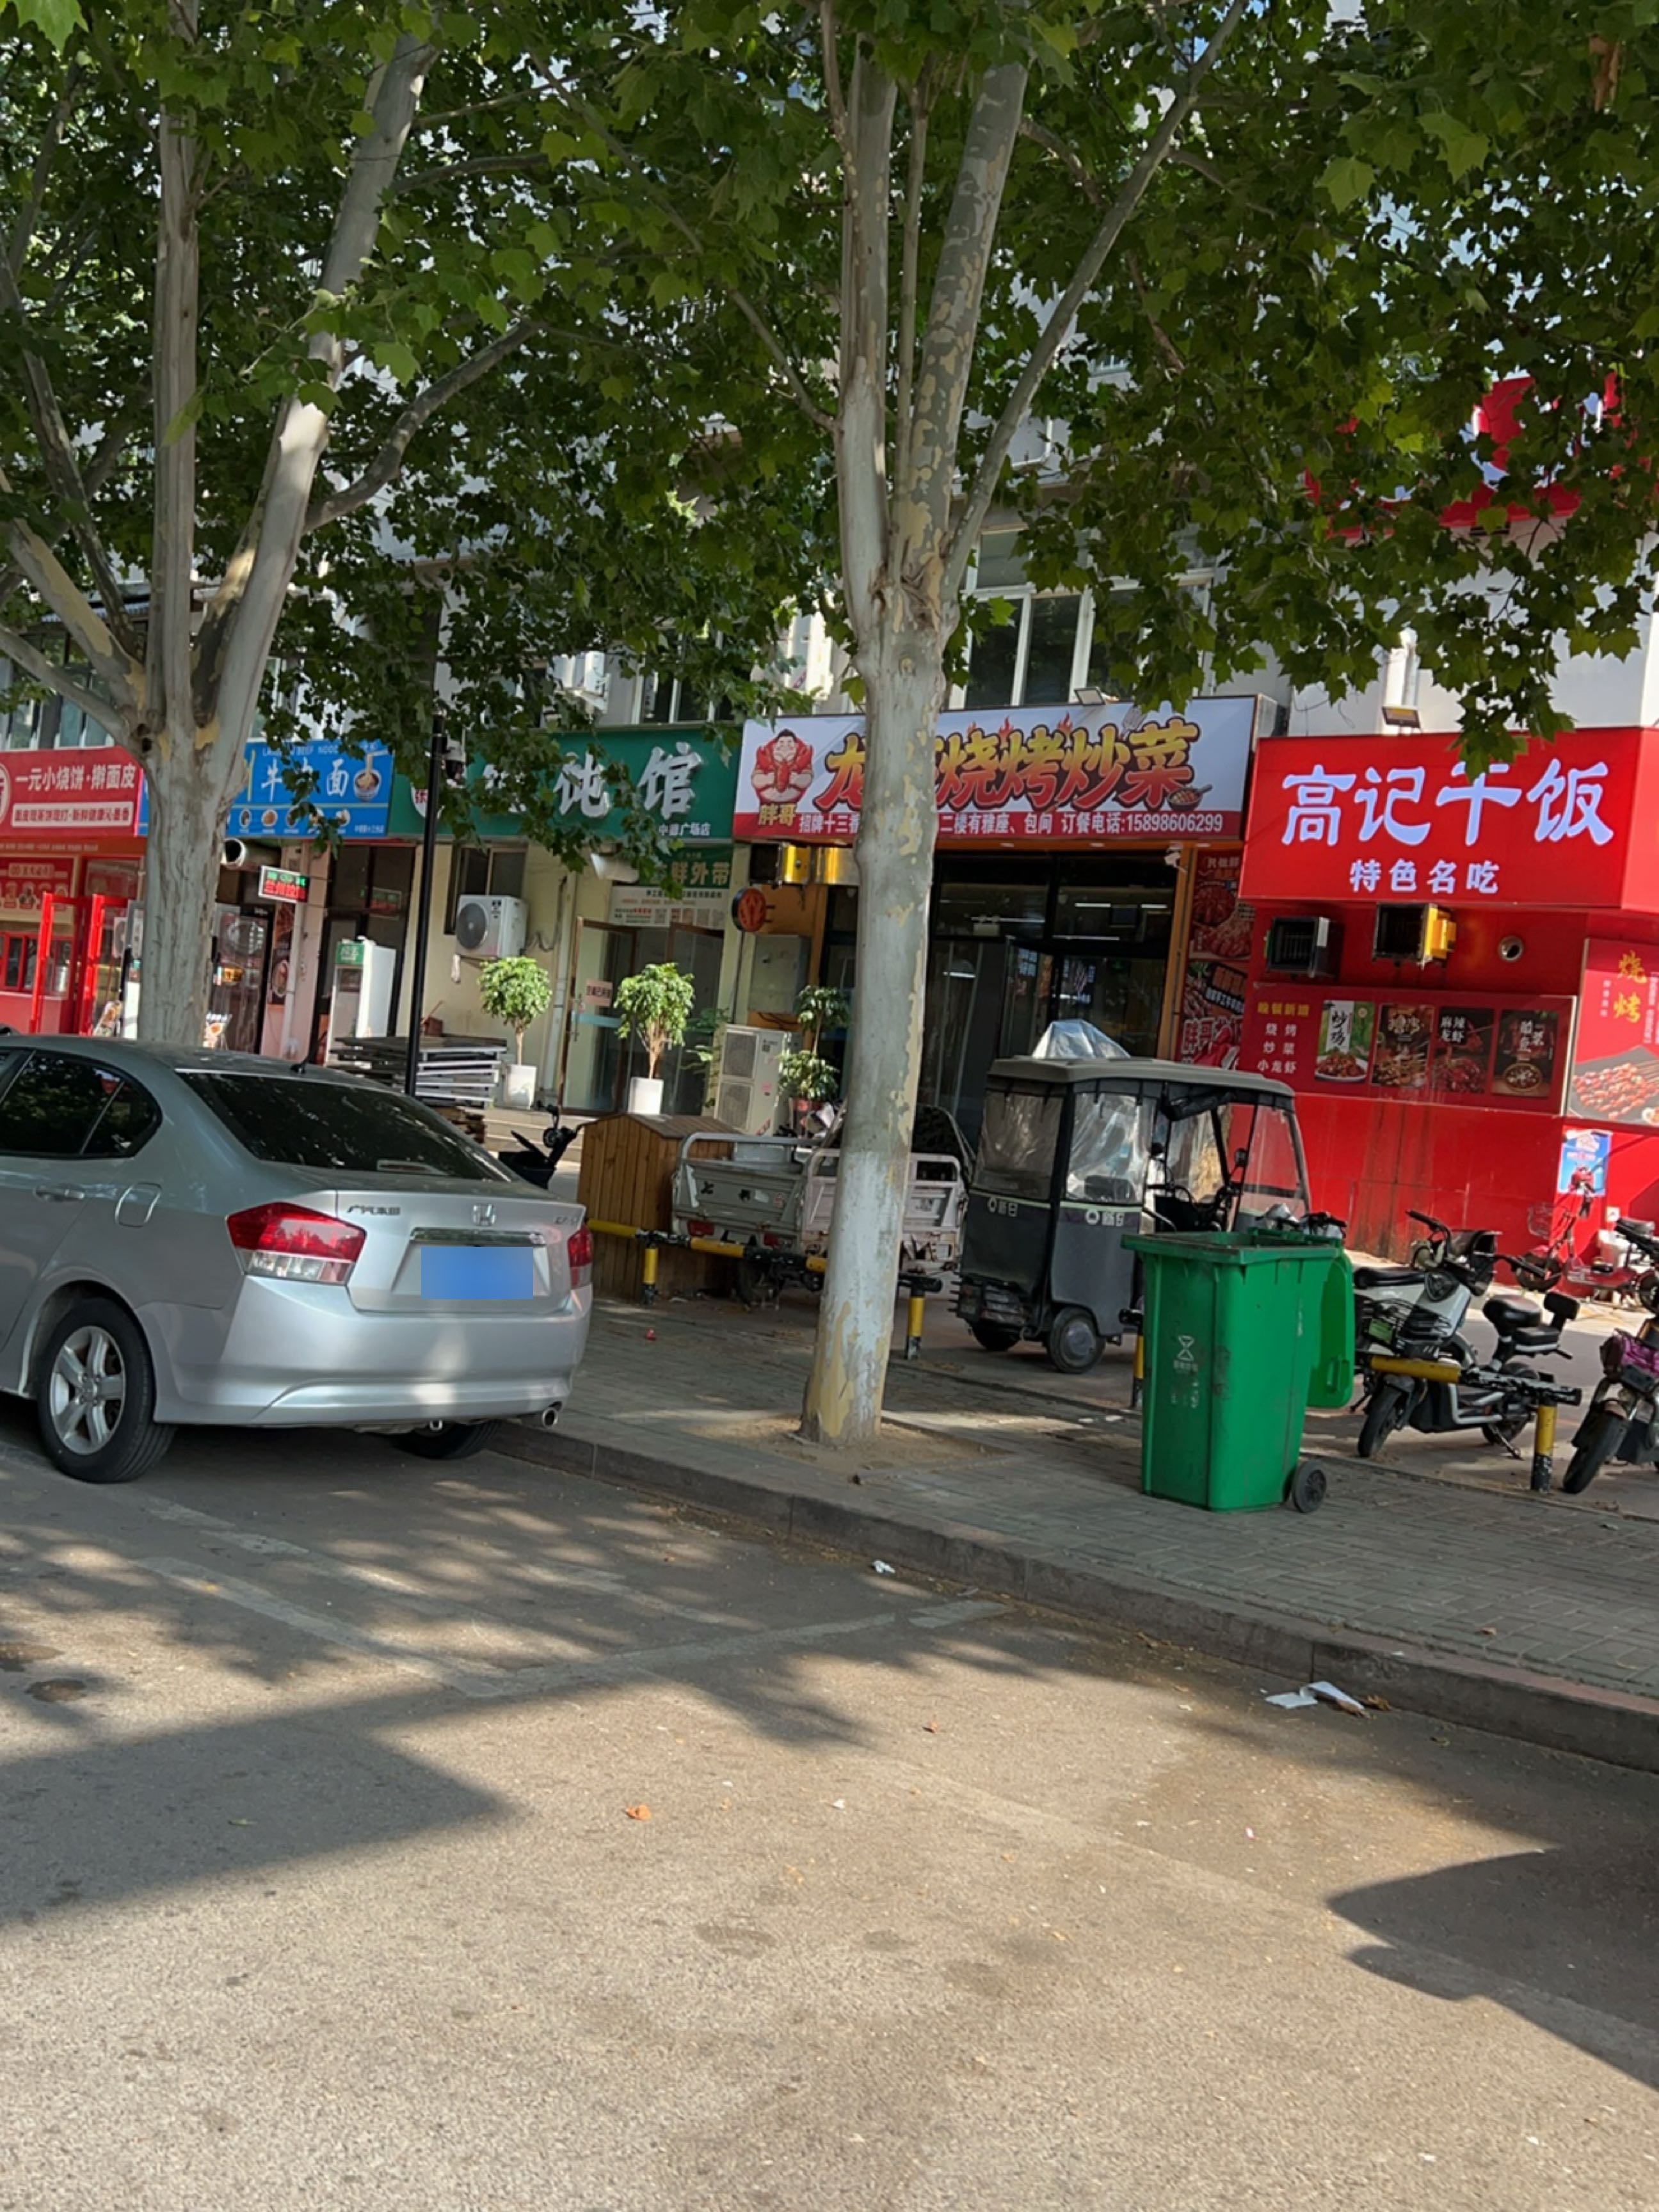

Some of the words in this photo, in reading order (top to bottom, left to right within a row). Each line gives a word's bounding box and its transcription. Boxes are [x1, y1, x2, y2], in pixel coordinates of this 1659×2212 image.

[483, 741, 702, 820] 饨馆
[813, 716, 1201, 812] 龙烧烤炒菜
[759, 803, 797, 826] 胖哥
[1349, 858, 1500, 895] 特色名吃
